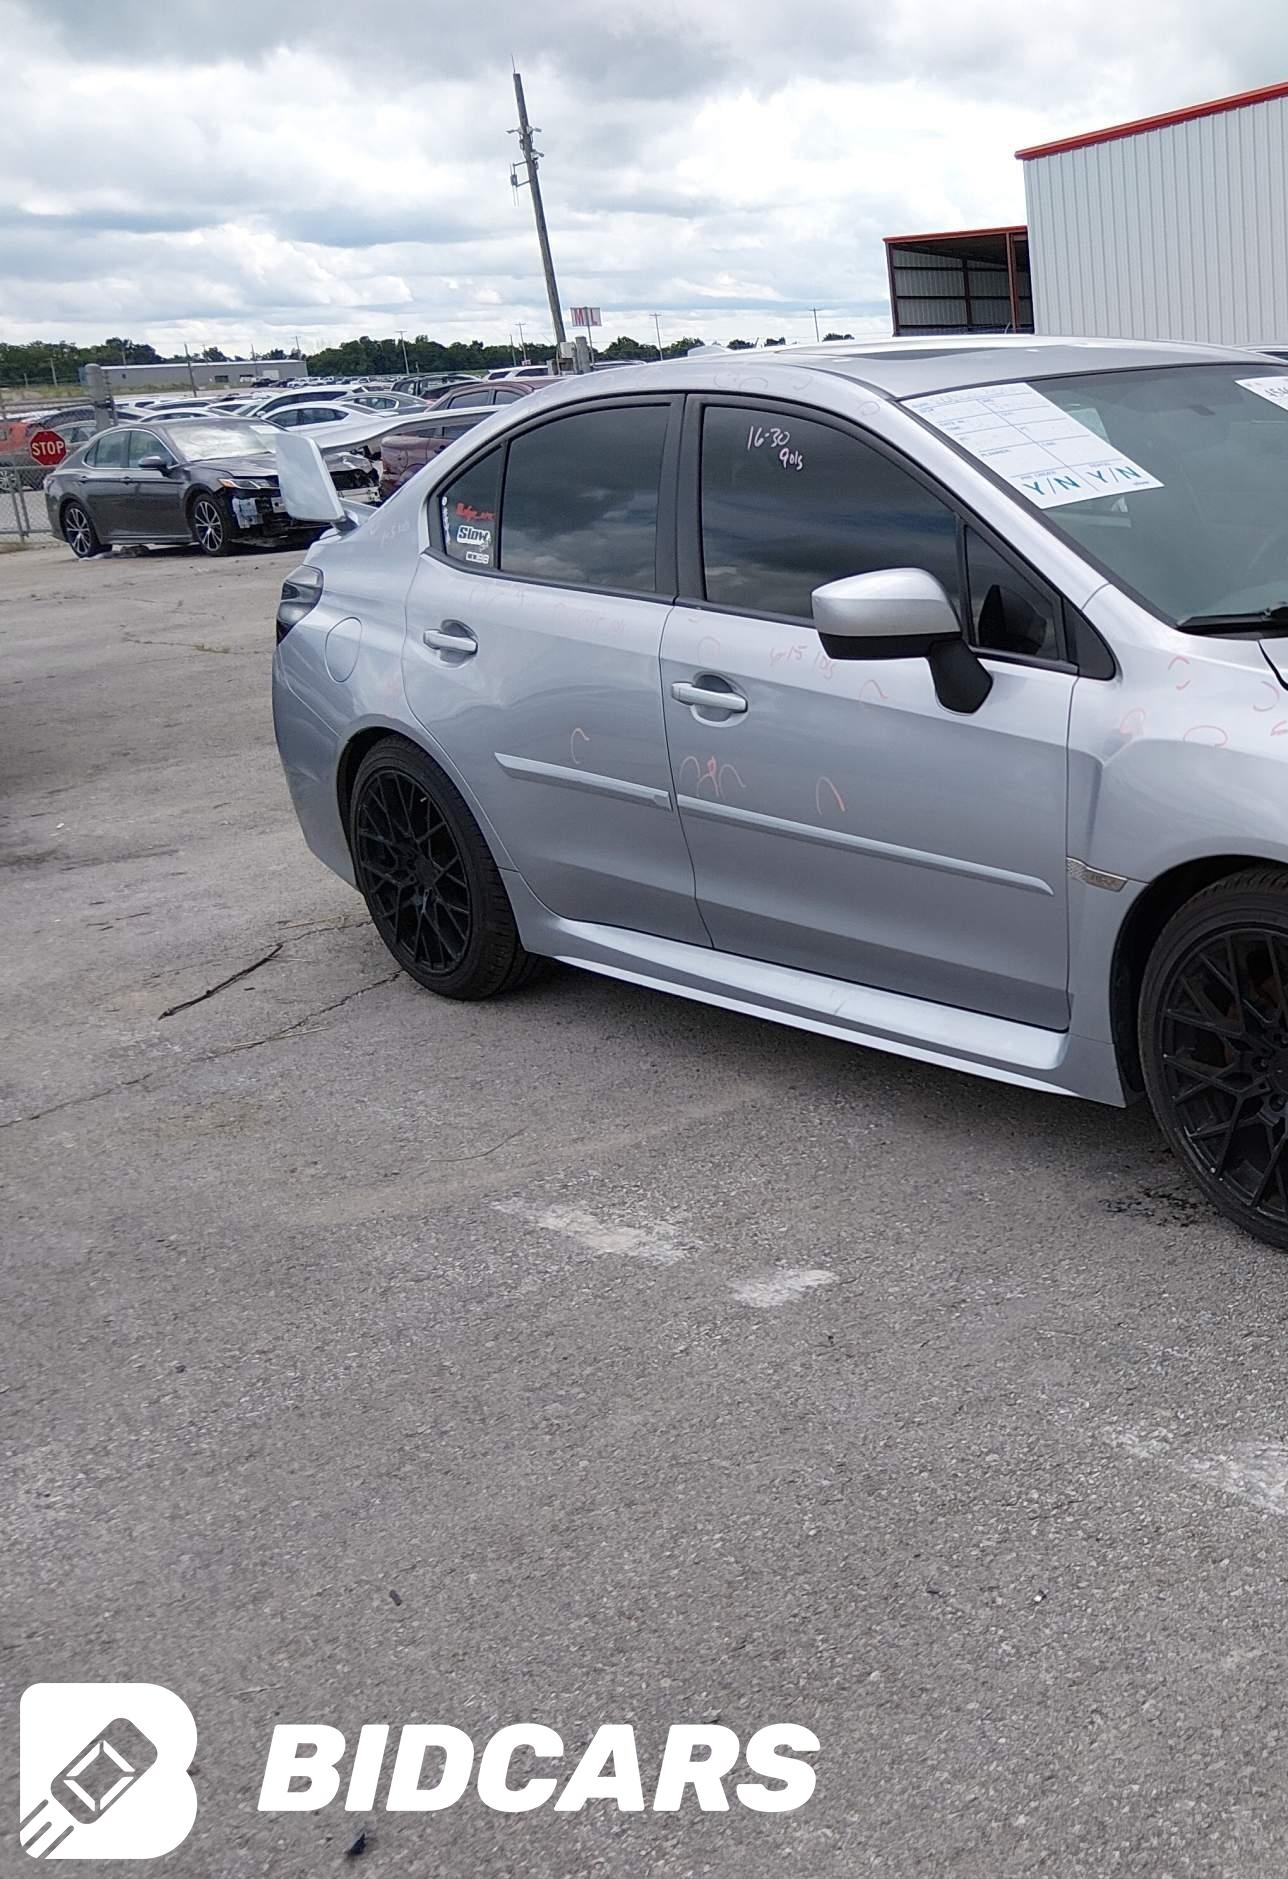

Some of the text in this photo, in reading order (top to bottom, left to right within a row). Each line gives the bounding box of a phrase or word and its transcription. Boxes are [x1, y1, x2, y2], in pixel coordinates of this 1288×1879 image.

[31, 440, 64, 456] STOP
[747, 426, 790, 450] 16-30
[1022, 475, 1081, 496] Y/N
